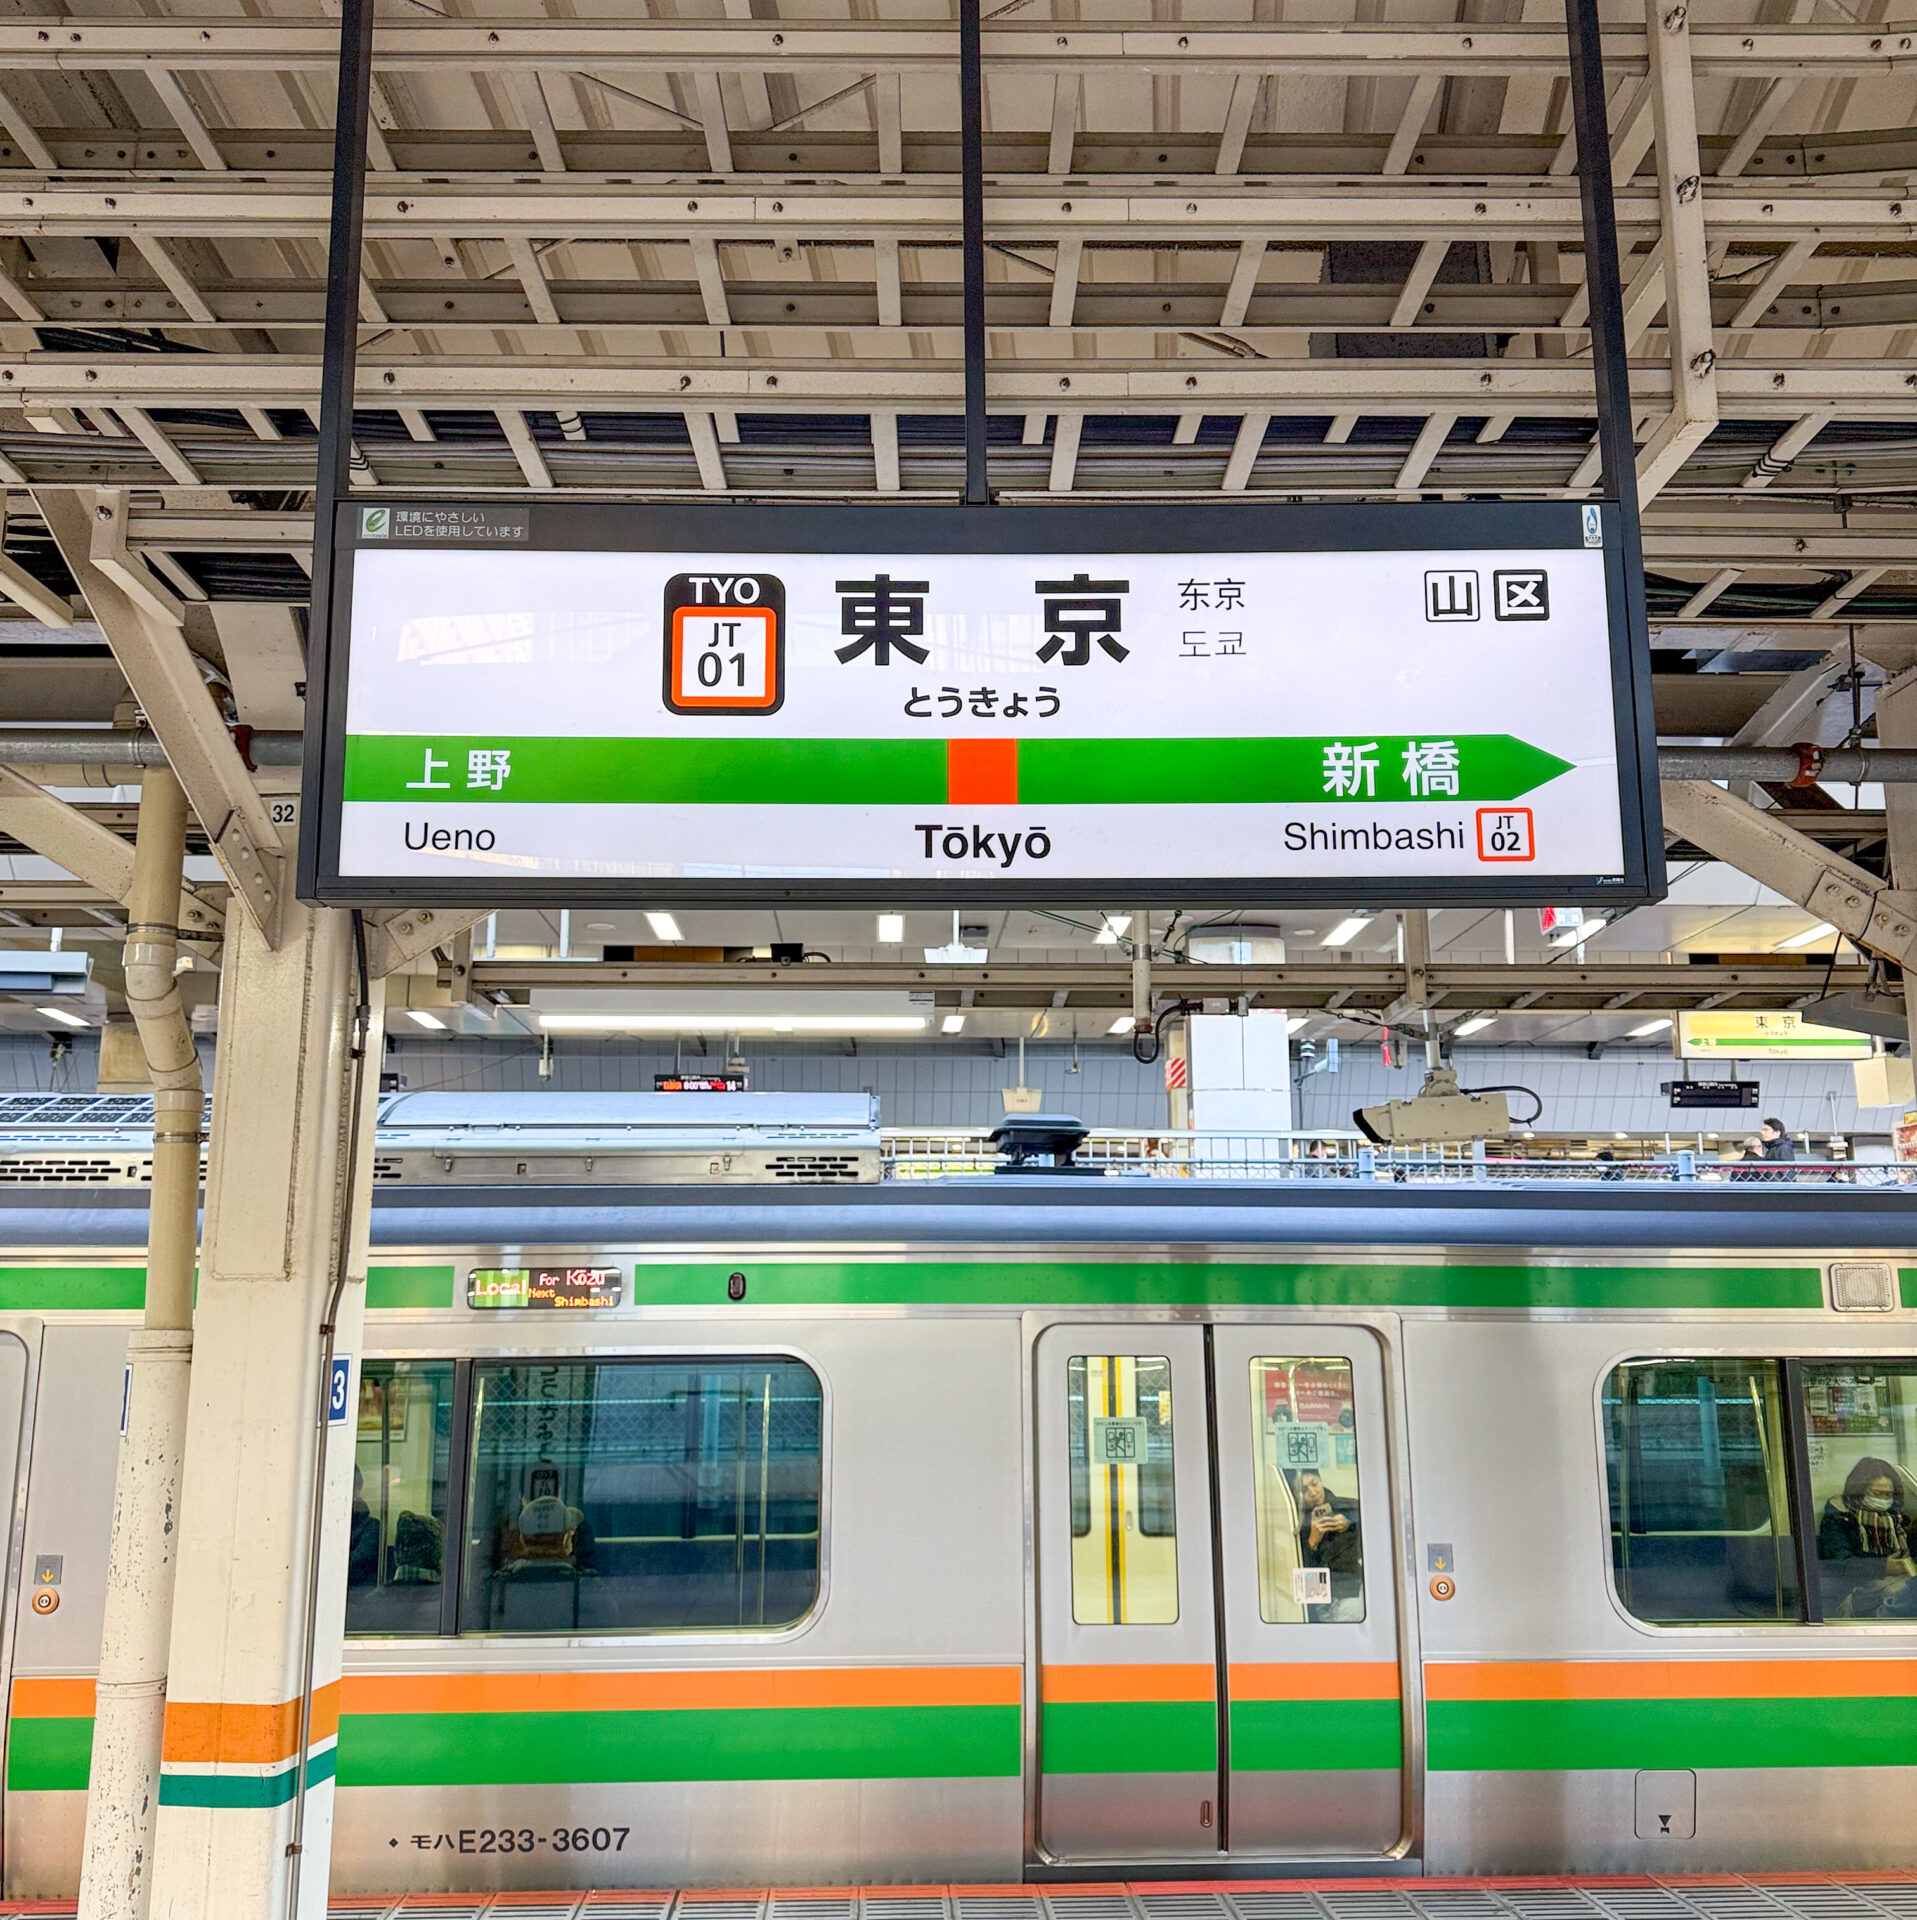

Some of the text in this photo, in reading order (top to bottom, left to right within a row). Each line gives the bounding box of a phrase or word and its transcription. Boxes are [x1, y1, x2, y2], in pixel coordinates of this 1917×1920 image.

[396, 511, 485, 523] 環境にやさしい
[395, 525, 524, 538] LEDを使用しています
[689, 577, 760, 604] TYO
[1178, 578, 1246, 611] 东京
[835, 574, 1130, 666] 東京
[708, 623, 741, 647] JT
[1178, 632, 1247, 657] 도쿄
[697, 652, 745, 687] 01
[904, 686, 1061, 718] とうきょう
[406, 748, 511, 790] 上野
[1322, 741, 1460, 797] 新橋
[272, 804, 295, 823] 32
[1496, 816, 1514, 829] JT
[405, 823, 496, 850] Ueno
[914, 825, 1051, 868] Tōkyō
[1284, 822, 1464, 851] Shimbashi
[1491, 832, 1521, 851] 02
[475, 1280, 526, 1297] Local
[528, 1288, 556, 1298] Next
[554, 1296, 614, 1307] Shimbashi
[332, 1369, 346, 1410] 3
